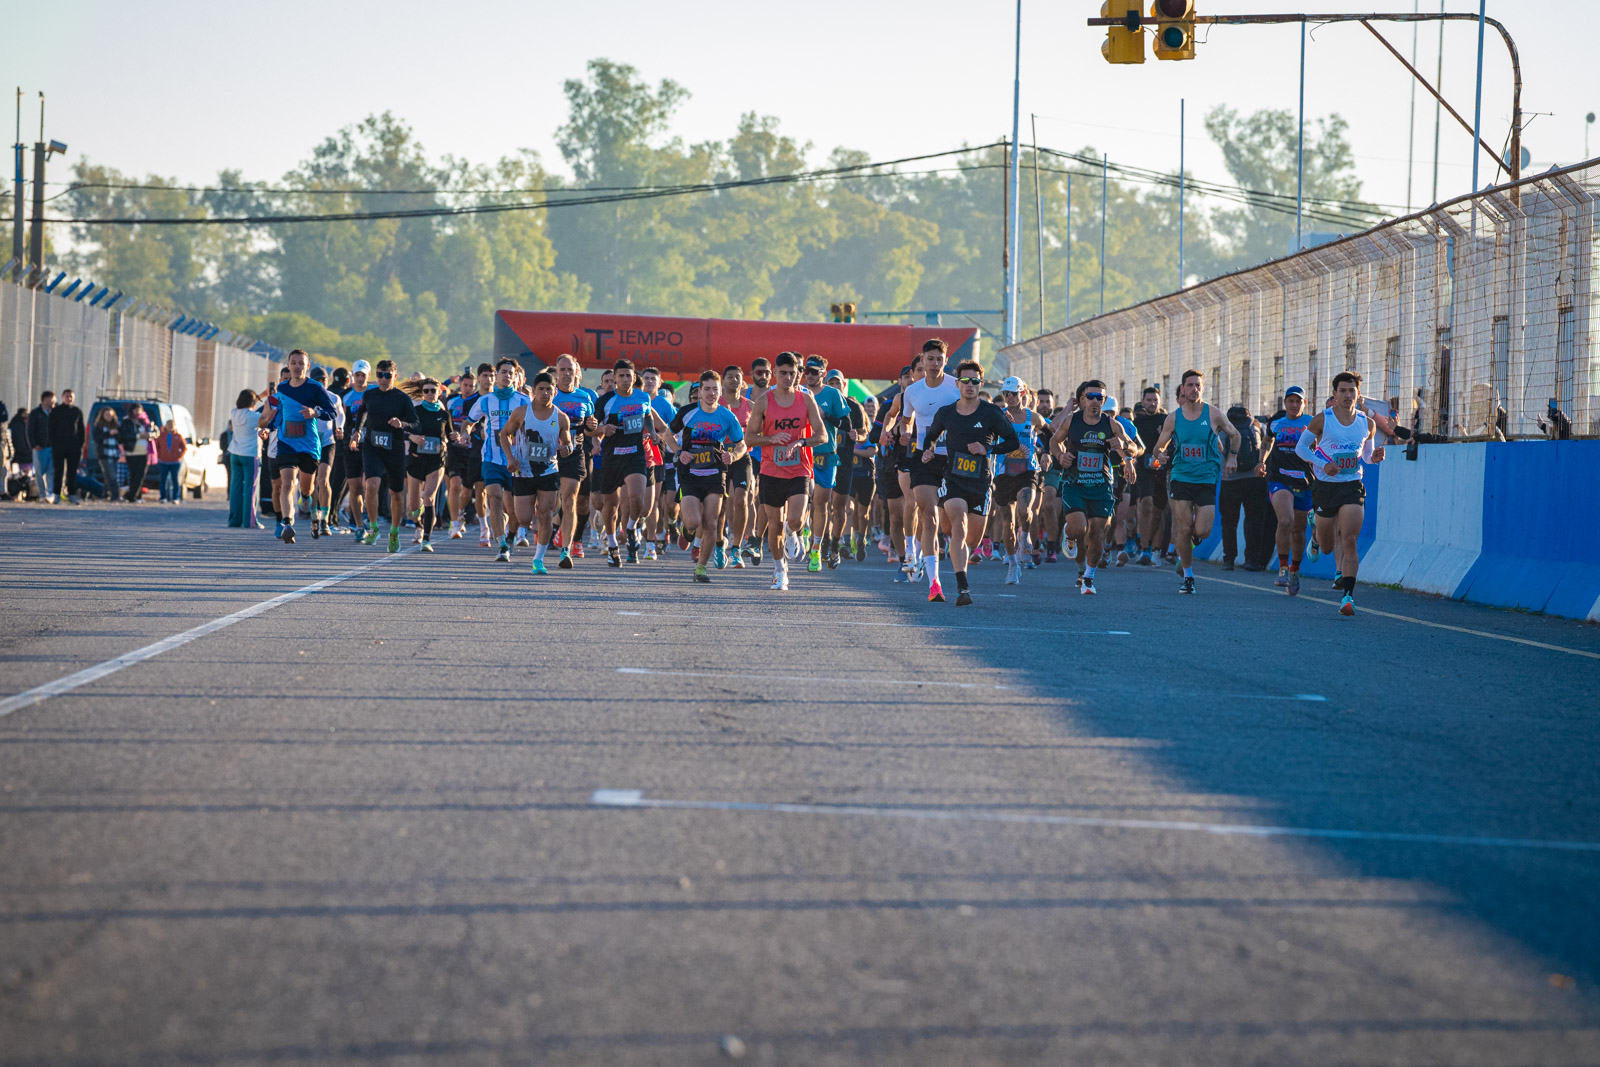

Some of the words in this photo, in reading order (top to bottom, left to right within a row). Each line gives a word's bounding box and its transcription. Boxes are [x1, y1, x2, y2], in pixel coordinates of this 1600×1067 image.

[627, 418, 642, 430] 105
[774, 417, 801, 431] KRC
[375, 435, 389, 446] 167
[530, 446, 549, 458] 174
[693, 451, 711, 465] 707
[1184, 447, 1202, 458] 344
[957, 457, 977, 473] 706
[1081, 456, 1099, 469] 317
[1339, 456, 1356, 470] 303
